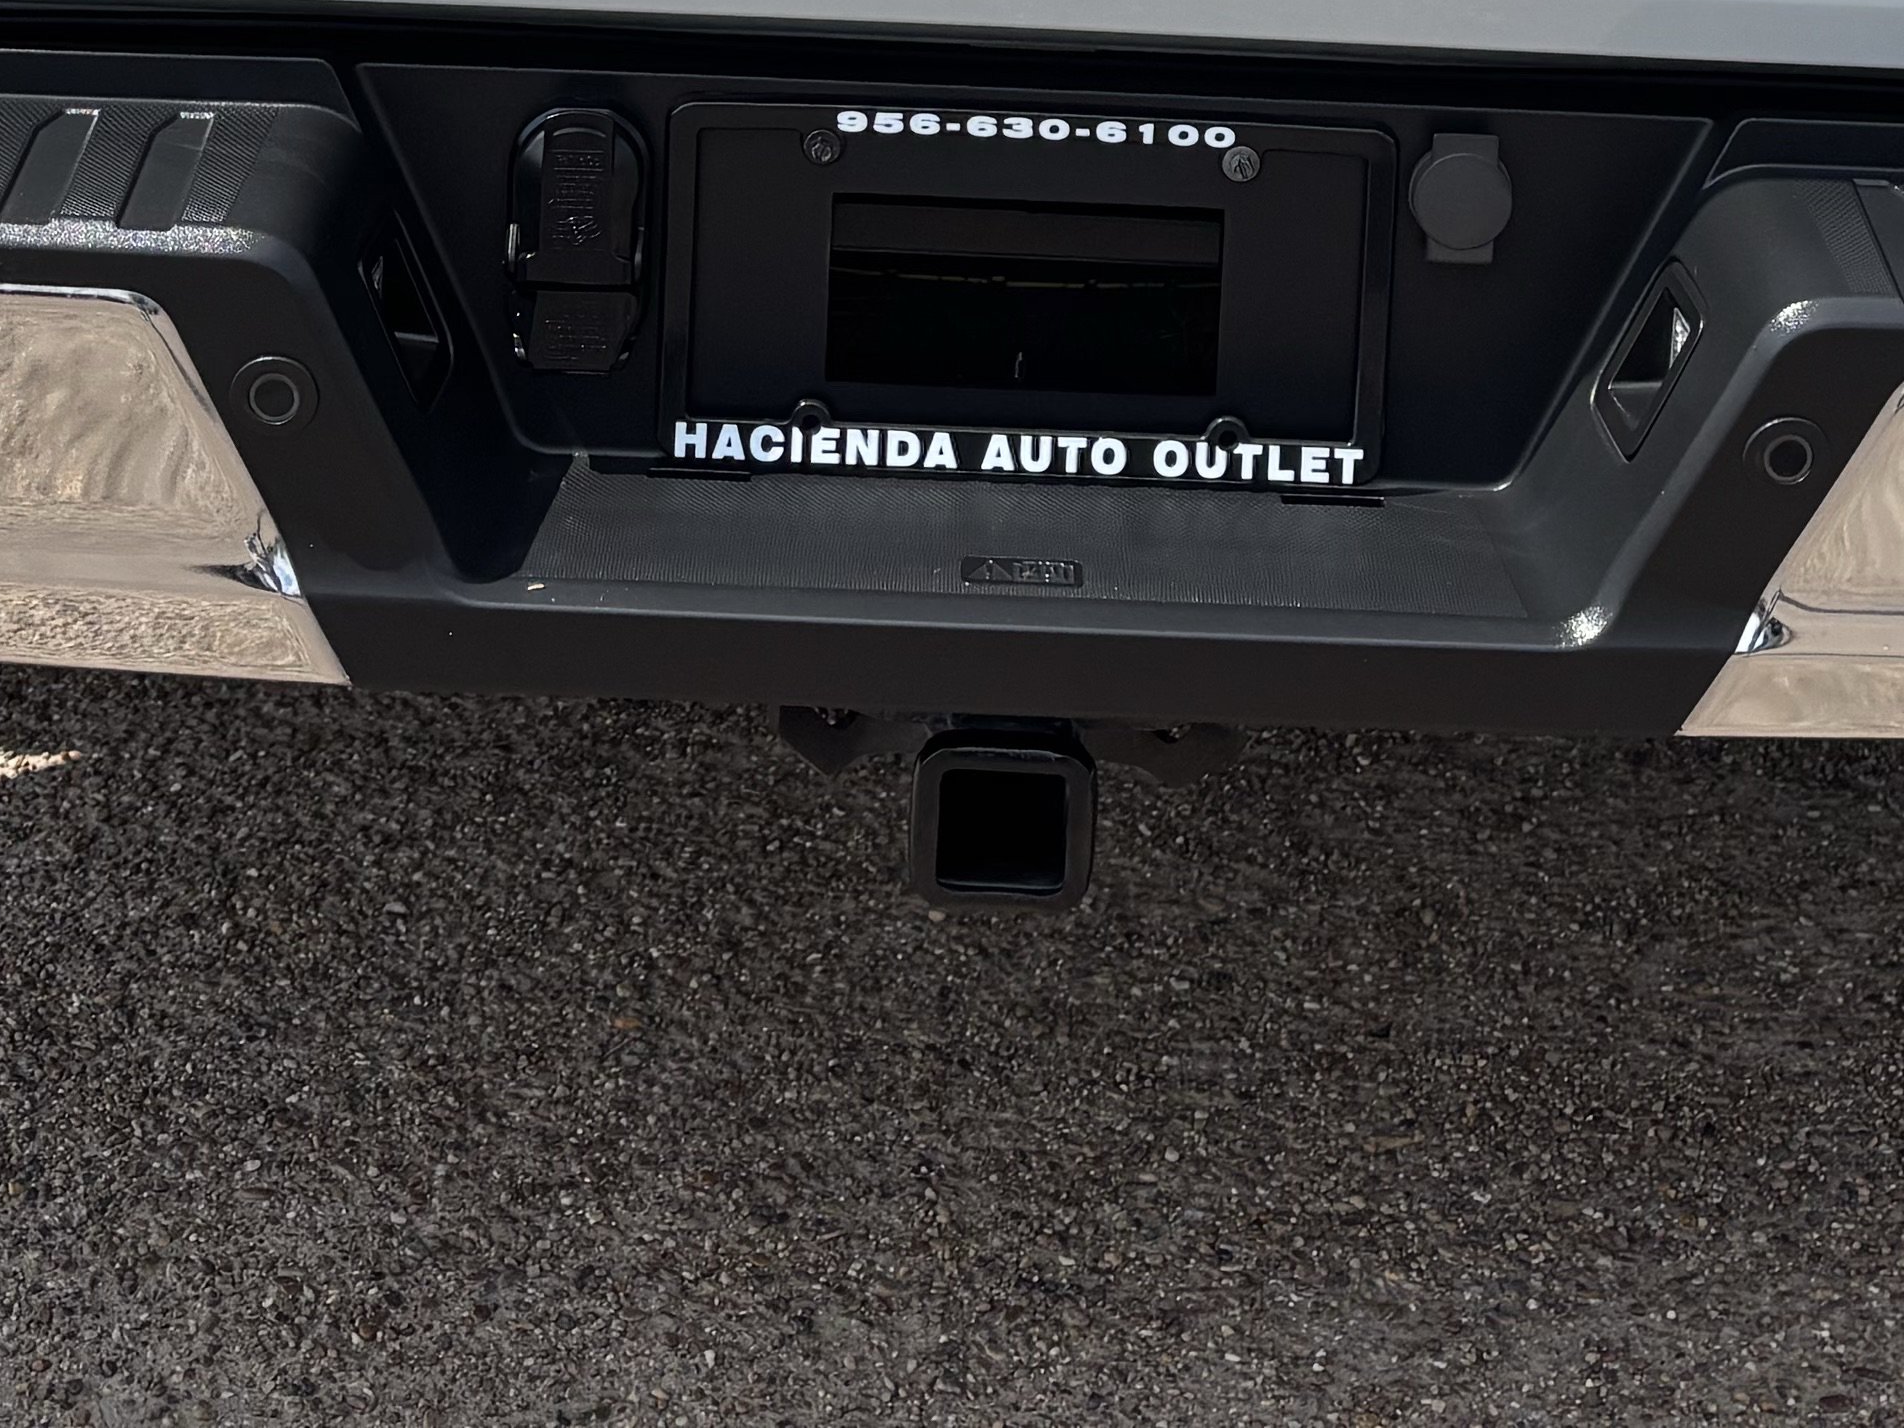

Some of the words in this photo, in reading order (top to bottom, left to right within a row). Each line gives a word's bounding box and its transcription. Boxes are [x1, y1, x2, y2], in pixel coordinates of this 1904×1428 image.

[837, 110, 1236, 148] 956-630-6100
[673, 421, 959, 470] HACIENDA
[980, 433, 1126, 476] AUTO
[1152, 438, 1365, 485] OUTLET
